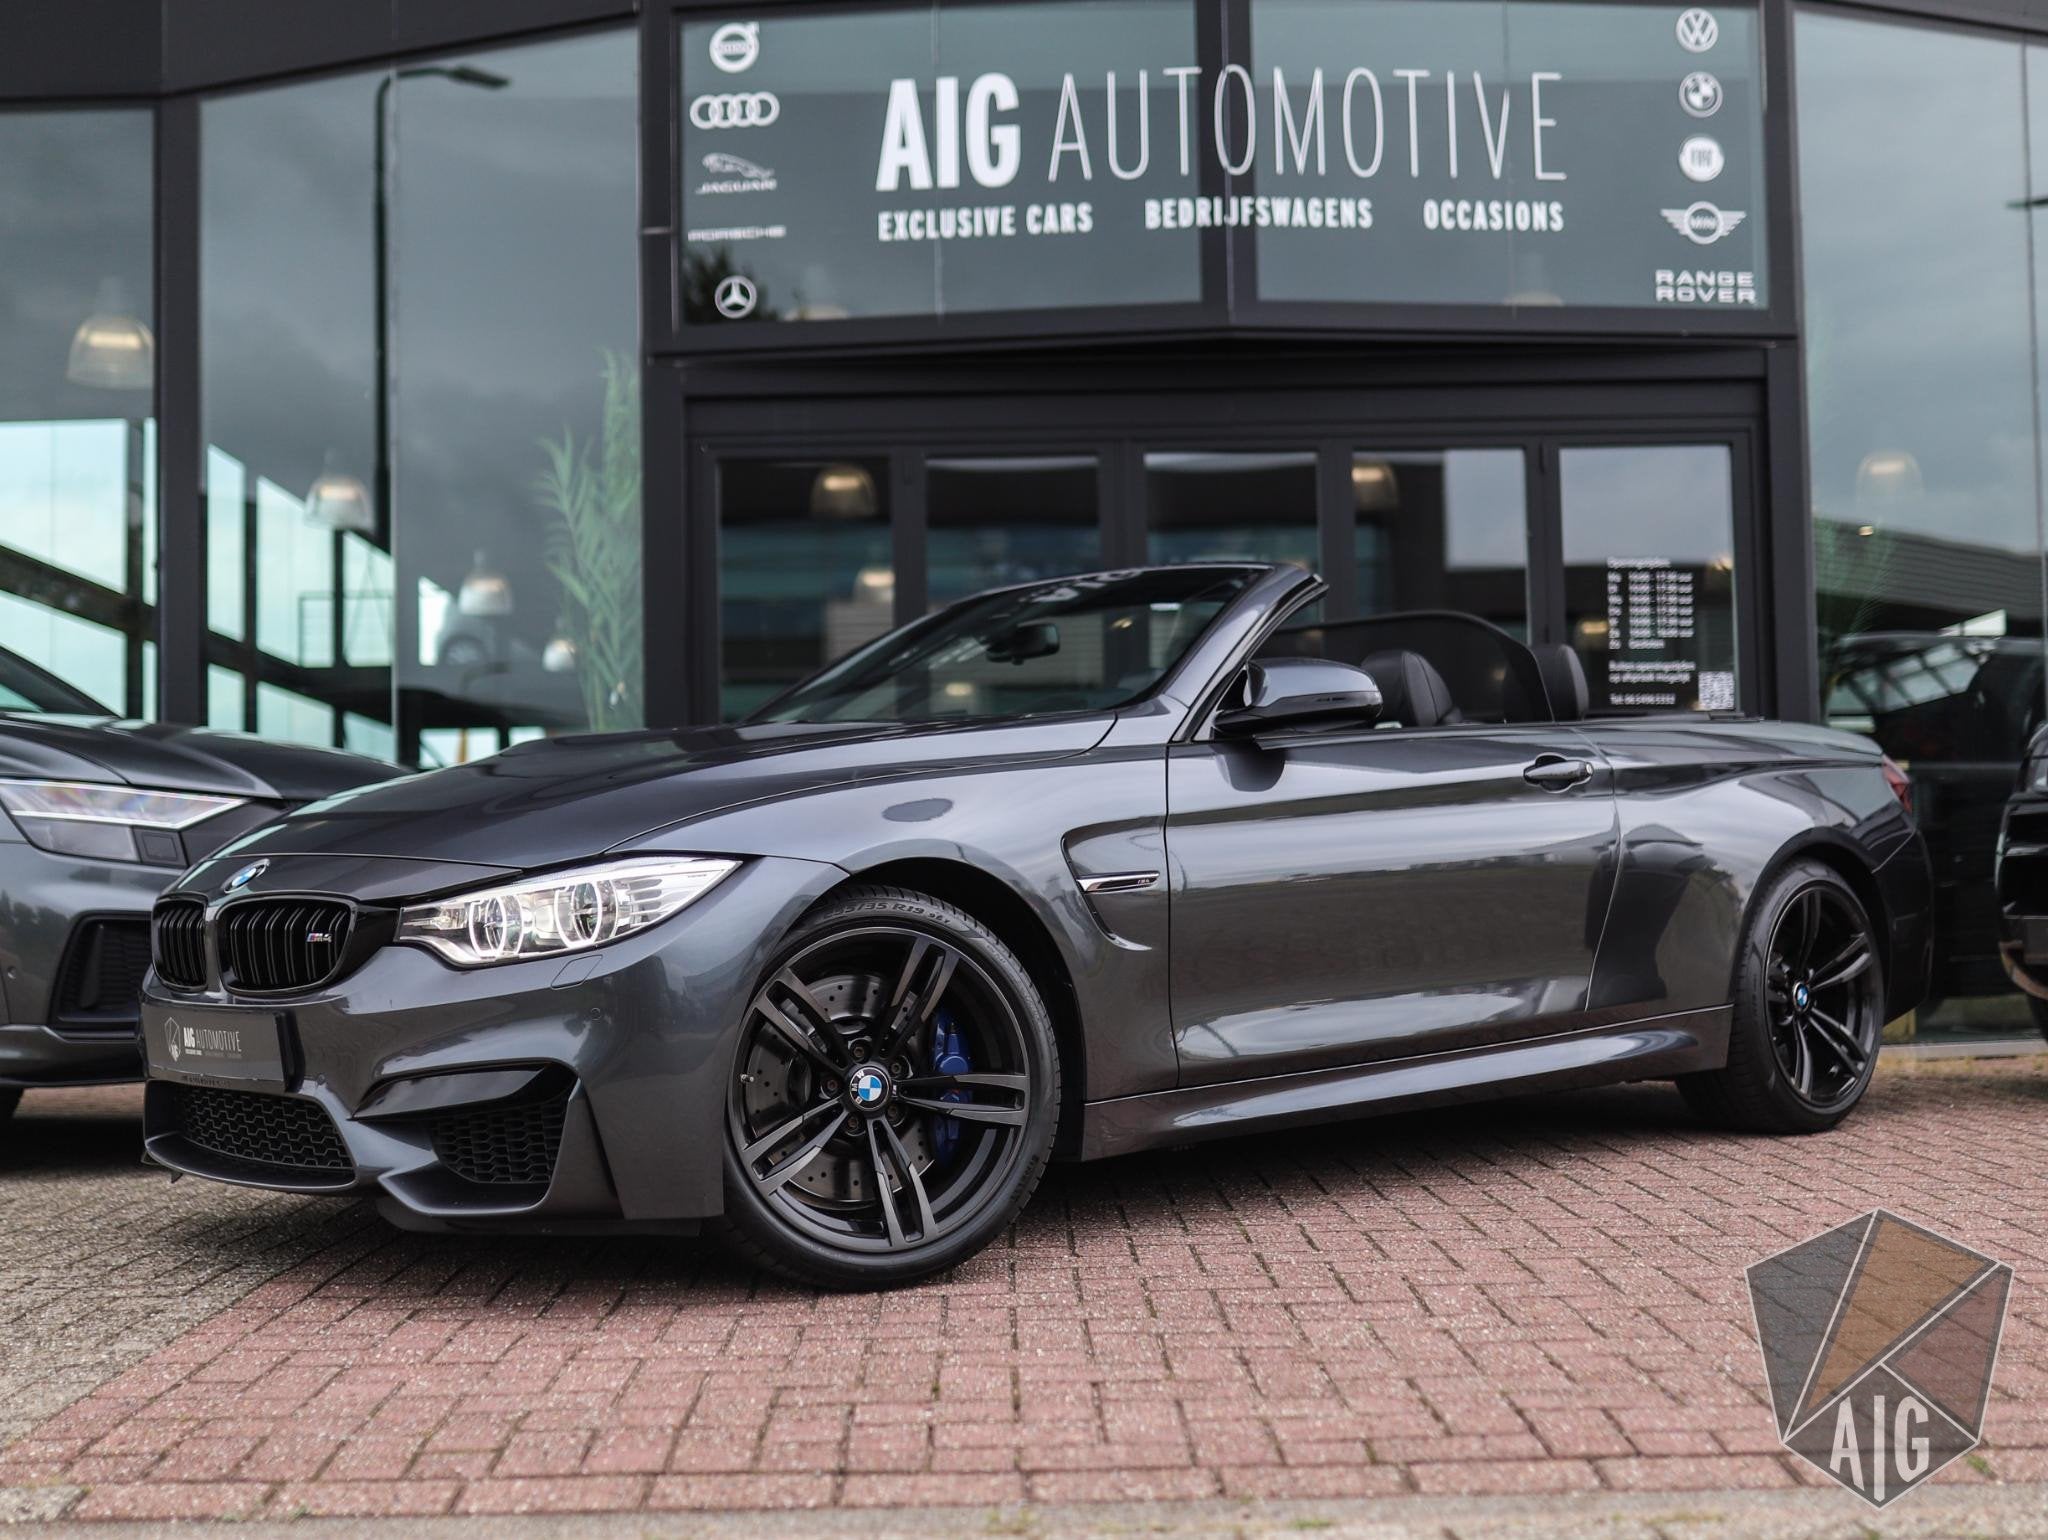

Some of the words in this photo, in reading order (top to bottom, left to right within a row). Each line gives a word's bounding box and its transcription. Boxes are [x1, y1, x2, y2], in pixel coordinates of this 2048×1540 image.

[876, 73, 1021, 191] AIG
[1048, 64, 1567, 182] AUTOMOTIVE
[878, 208, 1017, 242] EXCLUSIVE
[1026, 202, 1093, 236] CARS
[1145, 196, 1374, 230] BEDRIJFSWAGENS
[1423, 199, 1565, 232] OCCASIONS
[1655, 269, 1754, 287] RANGE
[1655, 286, 1756, 304] ROVER
[195, 1029, 242, 1052] AUTOMOTIVE
